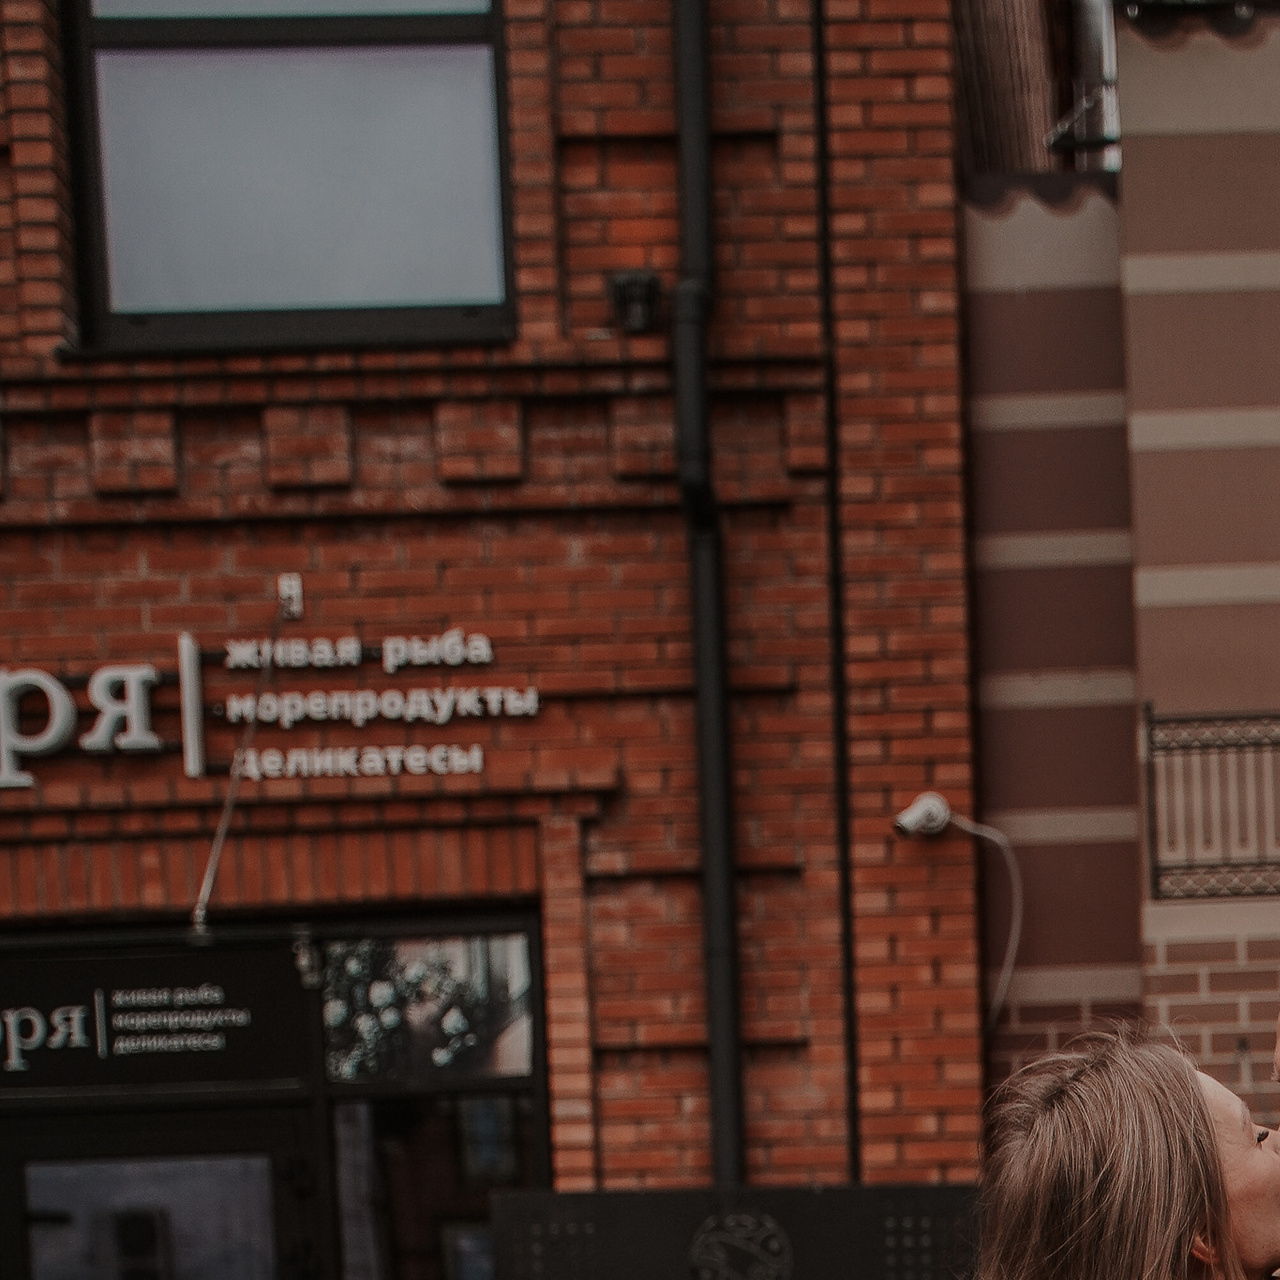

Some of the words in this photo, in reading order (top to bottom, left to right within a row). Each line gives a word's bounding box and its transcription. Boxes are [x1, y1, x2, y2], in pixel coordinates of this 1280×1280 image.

[225, 636, 362, 669] живая
[383, 627, 493, 673] рыба
[225, 686, 540, 729] морепродукты
[238, 743, 484, 782] деликатесы
